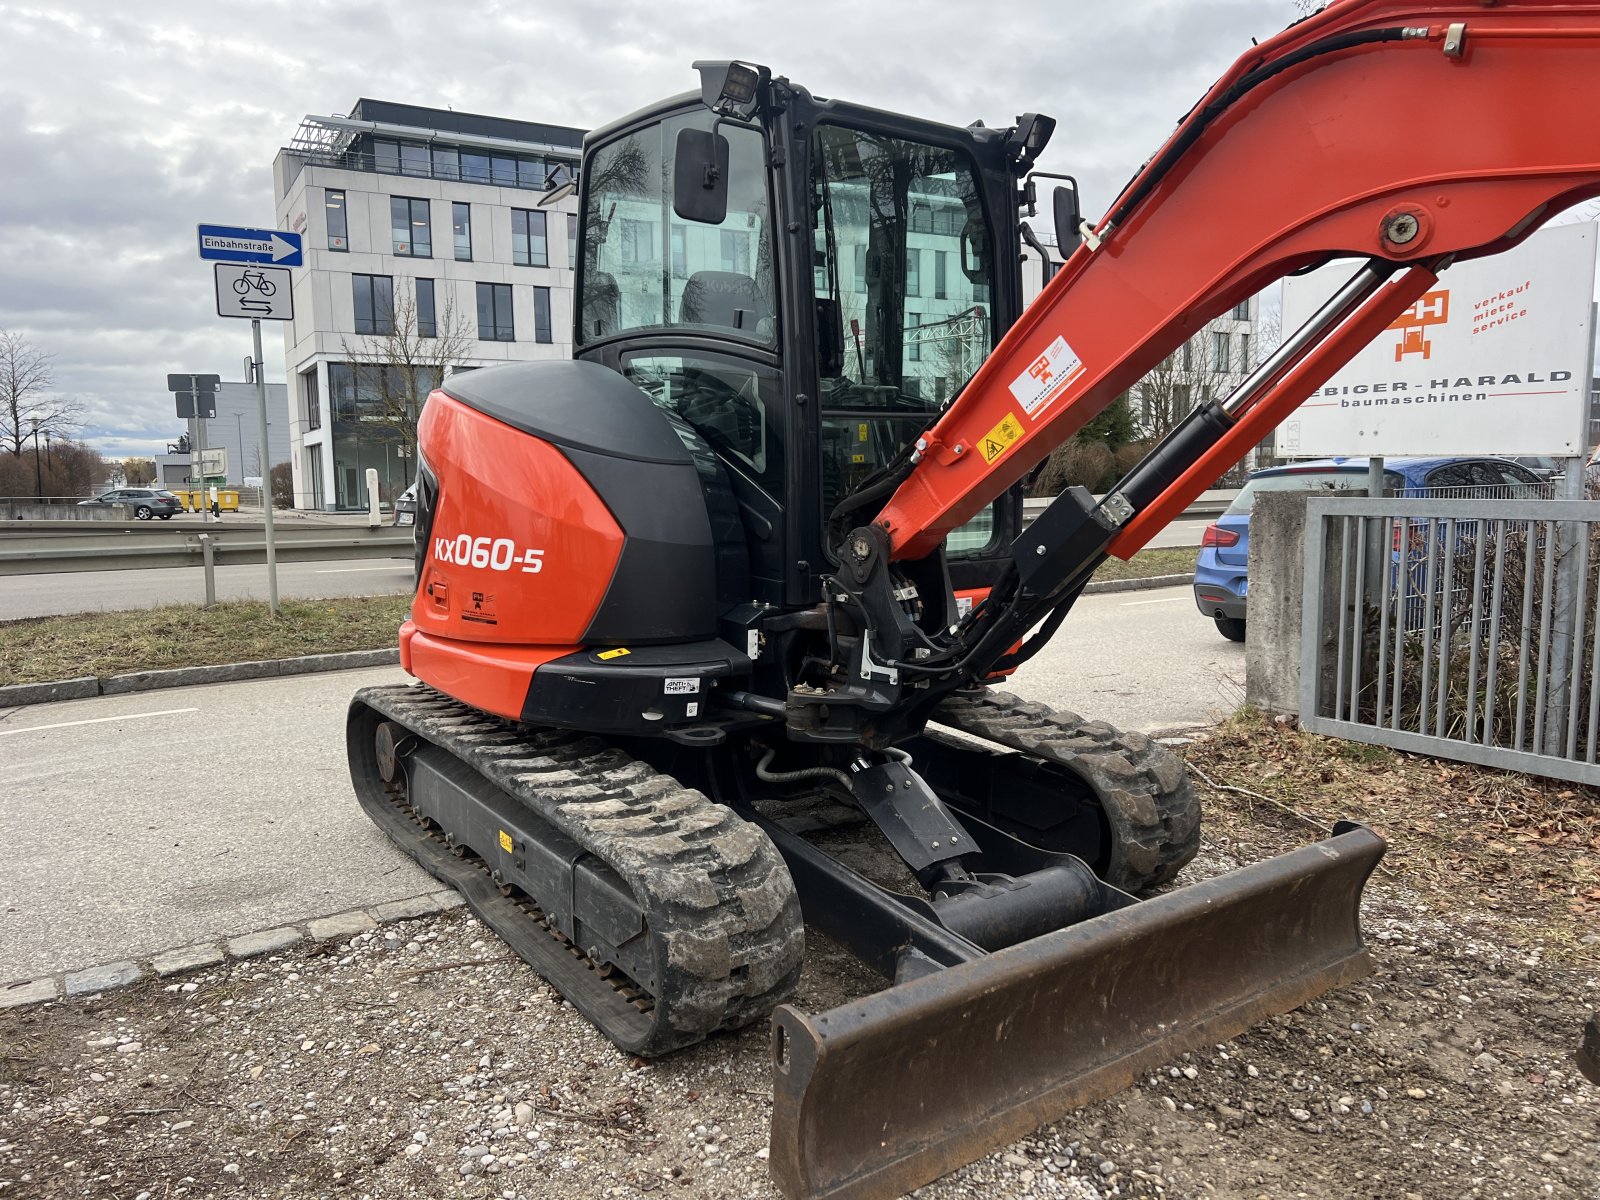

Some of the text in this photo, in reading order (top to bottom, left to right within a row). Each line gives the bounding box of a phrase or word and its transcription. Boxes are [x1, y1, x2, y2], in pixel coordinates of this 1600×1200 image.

[204, 238, 274, 252] Einbahnstraße
[1473, 280, 1531, 310] verkauf
[1472, 308, 1528, 335] service
[1473, 301, 1515, 323] miete
[1430, 371, 1572, 389] HARALD
[1341, 392, 1487, 408] baumaschinen
[434, 534, 545, 573] KX060-5
